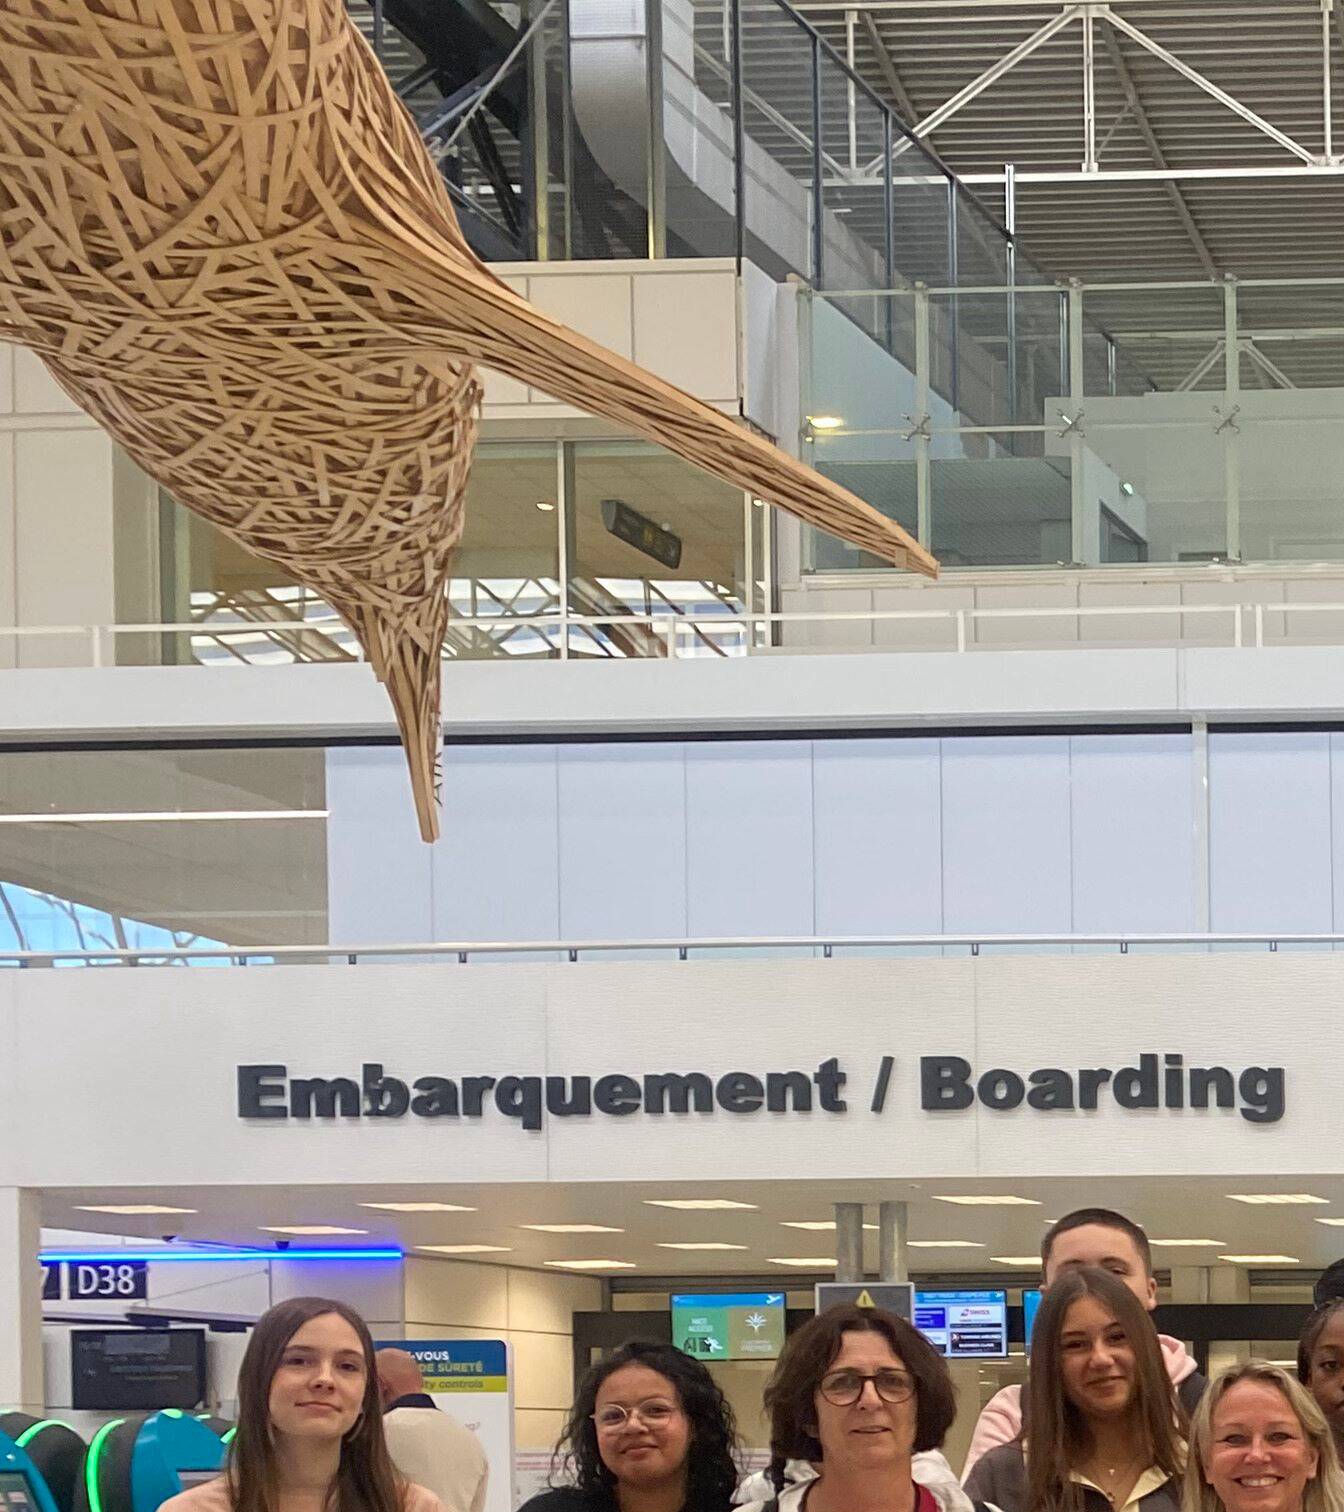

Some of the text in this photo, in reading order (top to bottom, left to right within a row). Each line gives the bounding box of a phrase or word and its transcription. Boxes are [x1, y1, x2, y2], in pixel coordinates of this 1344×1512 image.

[236, 1052, 1286, 1131] Embarquement / Boarding
[77, 1264, 135, 1295] D38
[438, 1380, 483, 1389] controls
